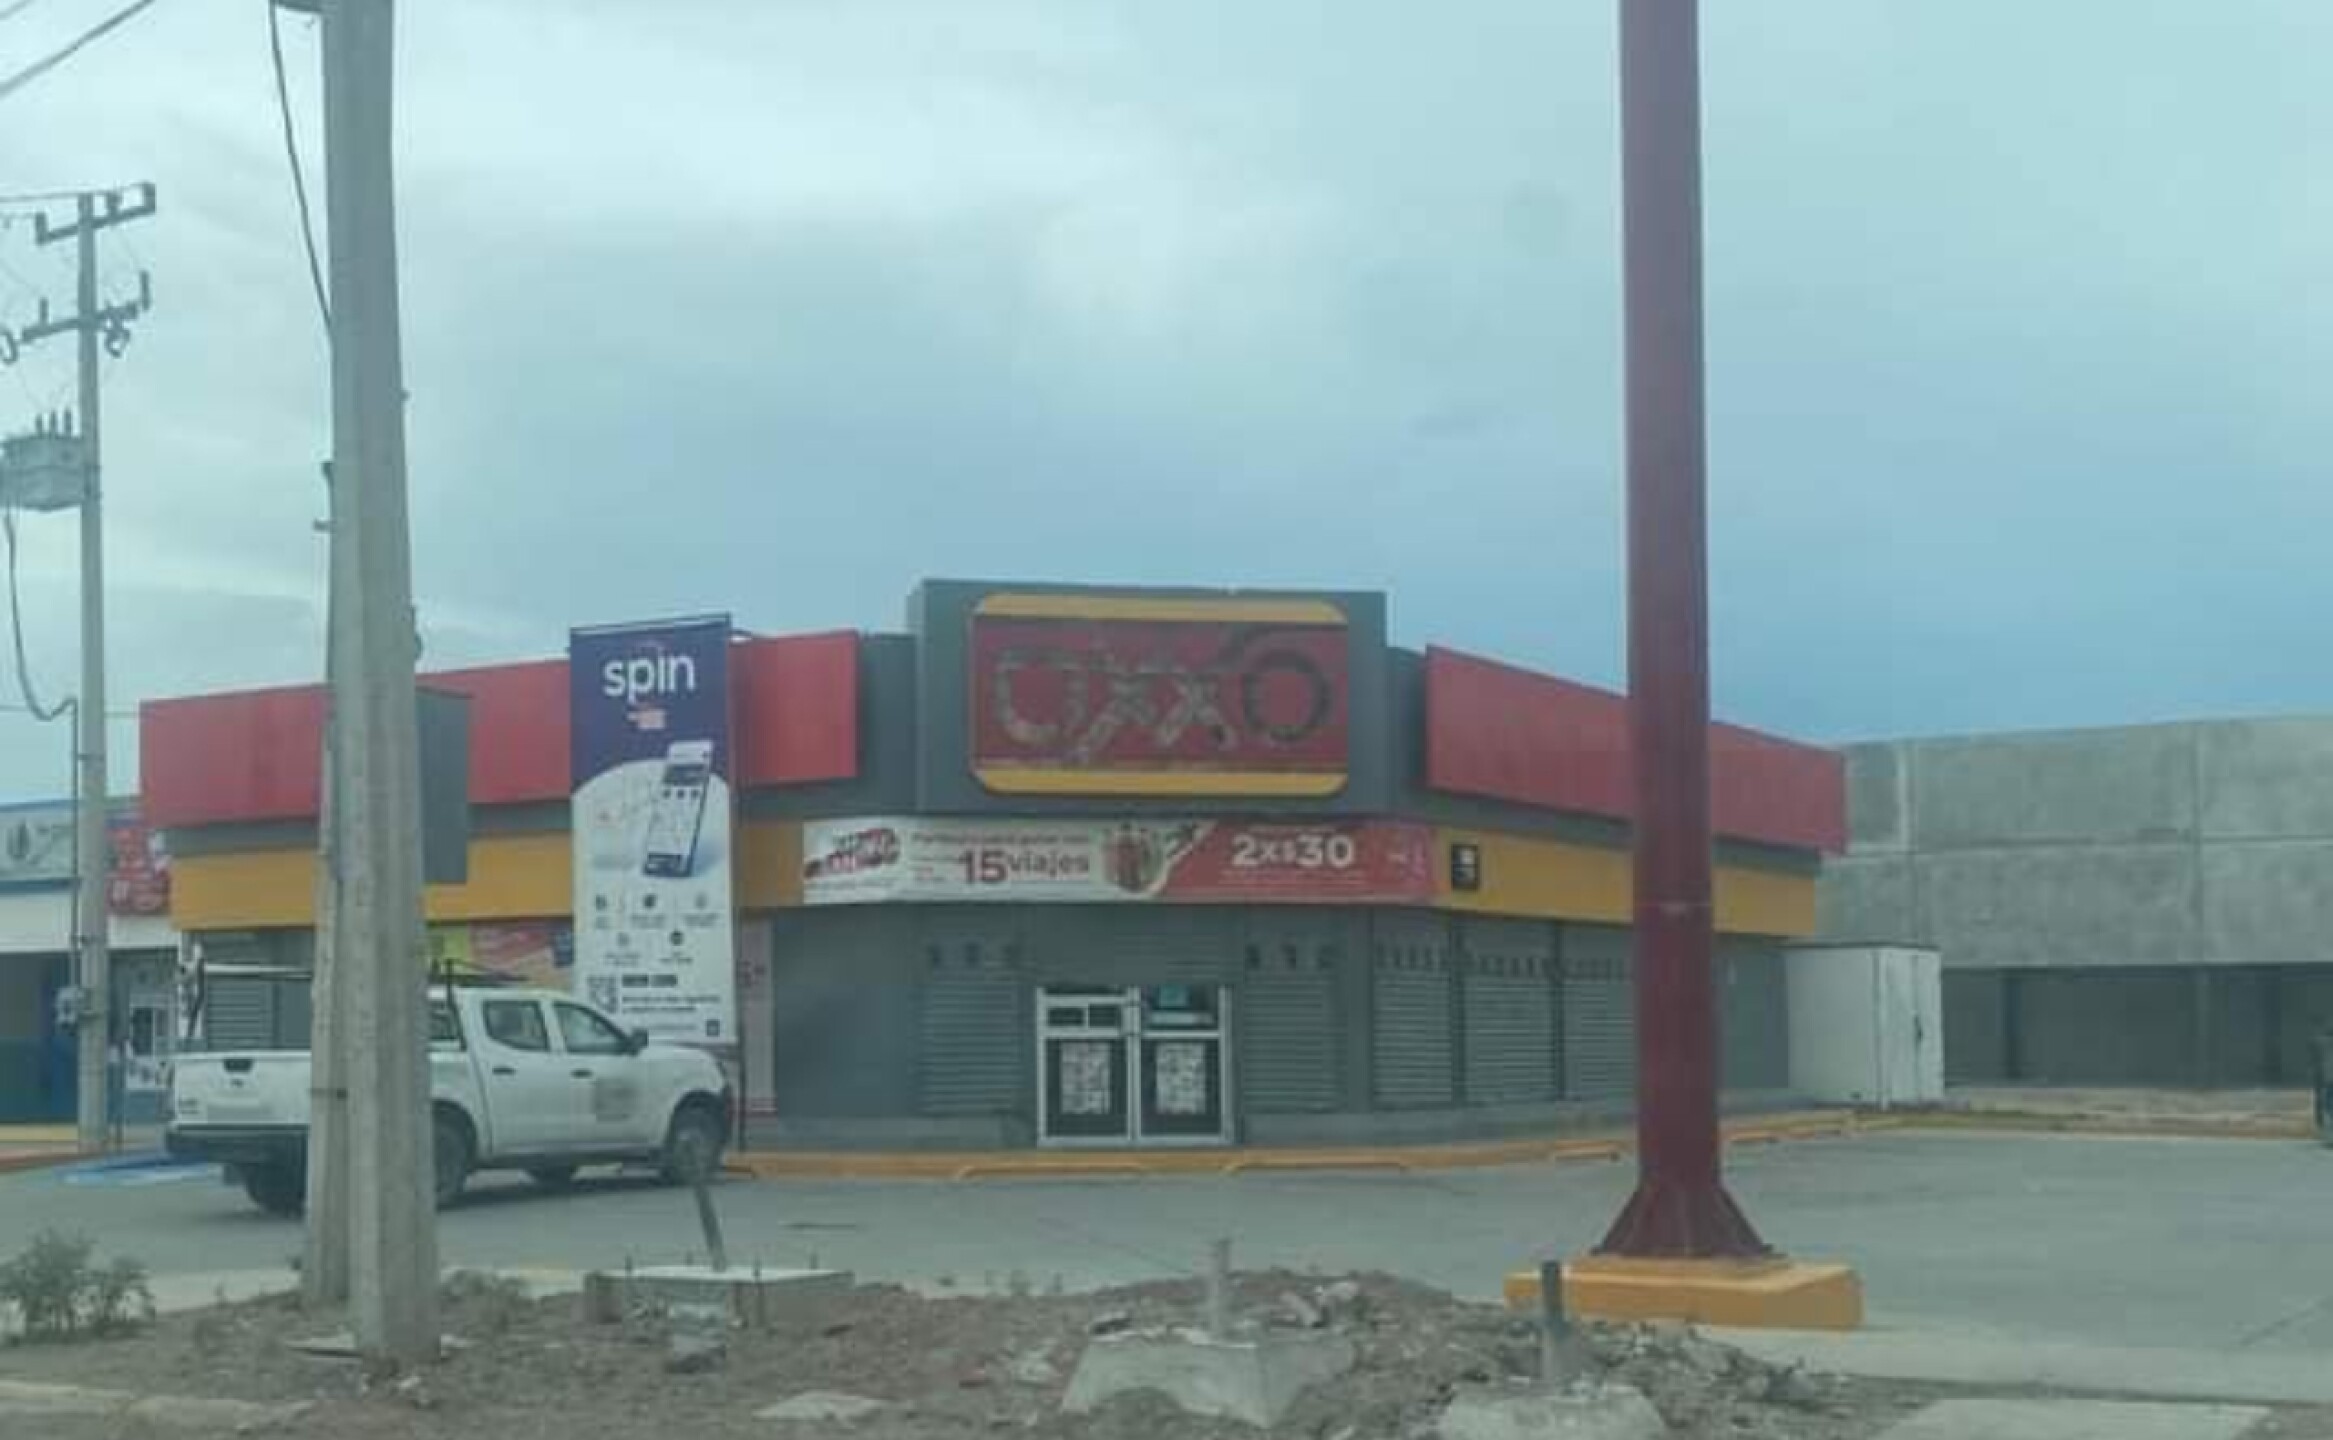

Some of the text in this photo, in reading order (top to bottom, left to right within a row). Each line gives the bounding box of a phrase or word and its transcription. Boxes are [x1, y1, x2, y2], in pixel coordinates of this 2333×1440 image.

[603, 653, 696, 705] spin
[959, 850, 1008, 884] 15
[1007, 848, 1091, 878] viajes
